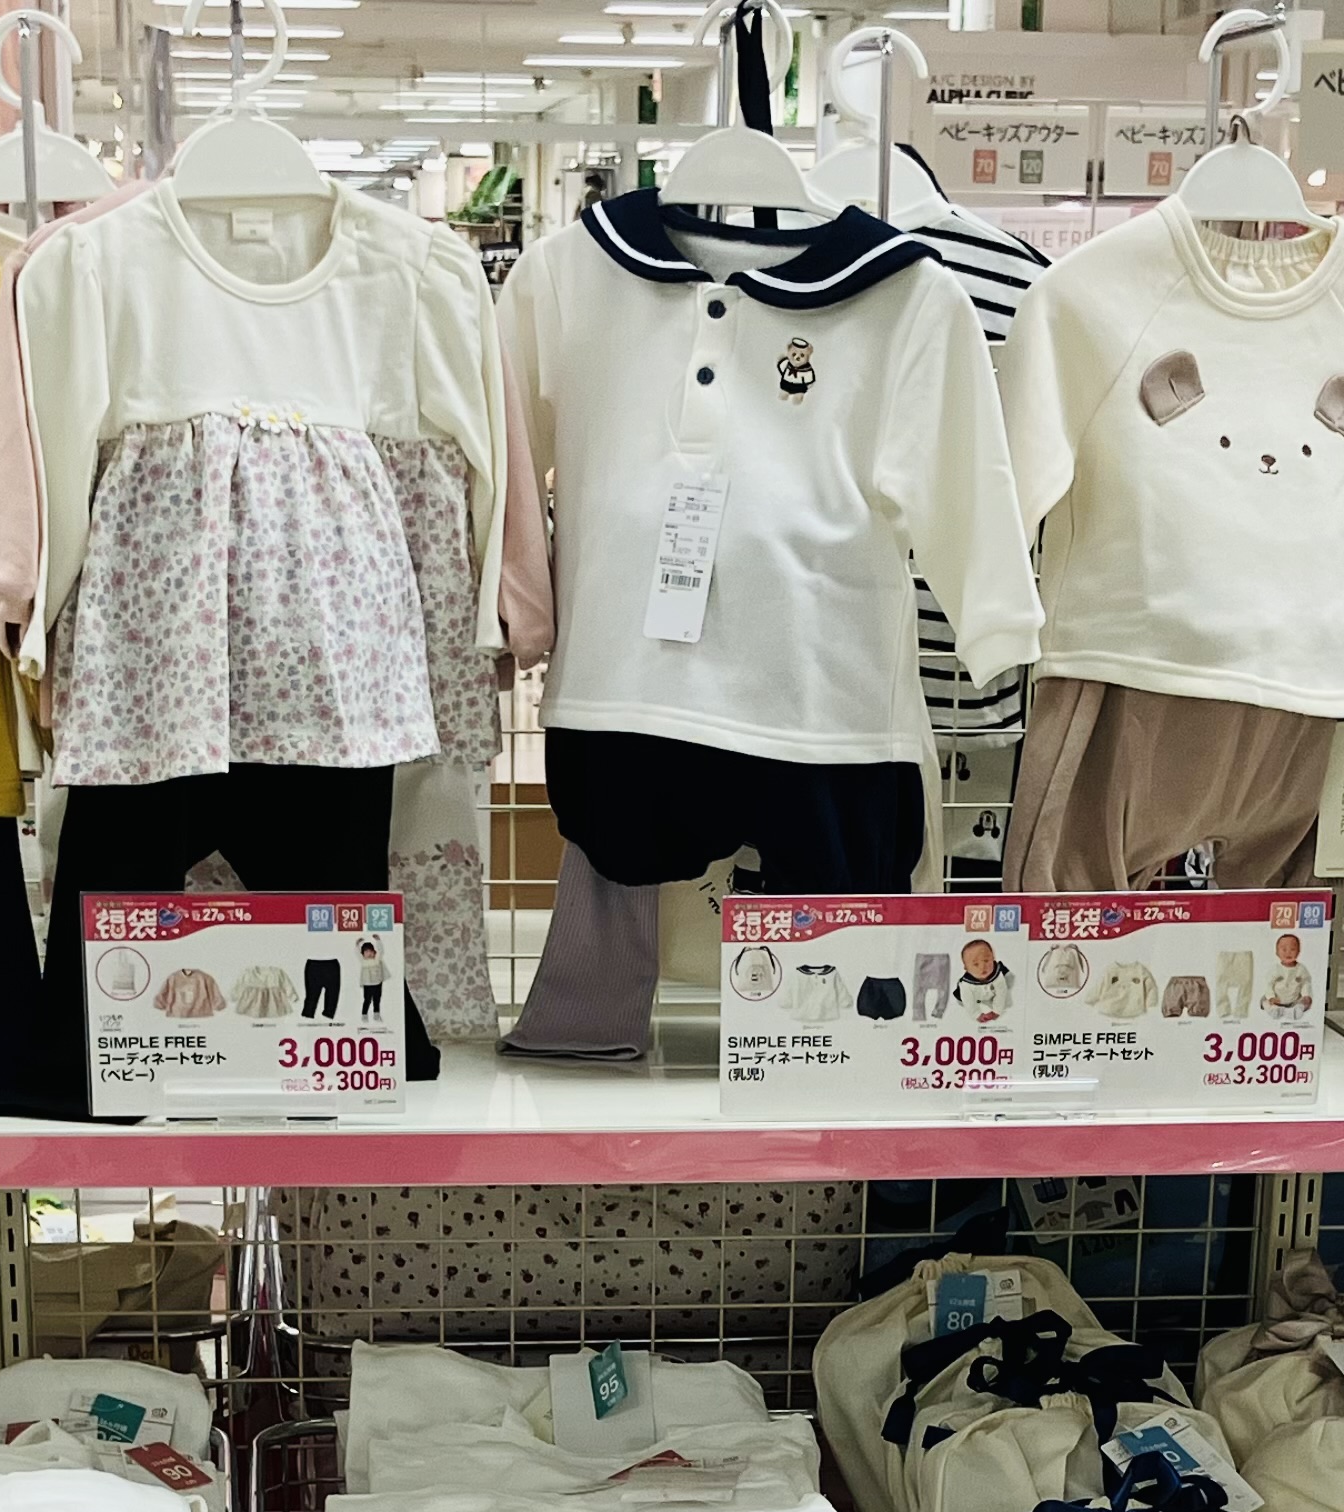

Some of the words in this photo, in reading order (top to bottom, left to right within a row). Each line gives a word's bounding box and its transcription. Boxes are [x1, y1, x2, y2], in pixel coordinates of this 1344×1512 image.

[939, 122, 1079, 143] ベビーキッズアウター
[164, 1036, 207, 1049] FREE
[792, 1035, 833, 1048] FREE
[1097, 1032, 1136, 1044] FREE
[278, 1037, 396, 1068] 3,000円
[900, 1035, 1013, 1067] 3,000円
[1033, 1047, 1154, 1061] コーディネートセット
[1203, 1031, 1315, 1063] 3,000円
[99, 1052, 227, 1065] コーディネートセット
[728, 1050, 850, 1065] コーディネートセット
[947, 1311, 973, 1330] 80
[599, 1374, 620, 1402] 95
